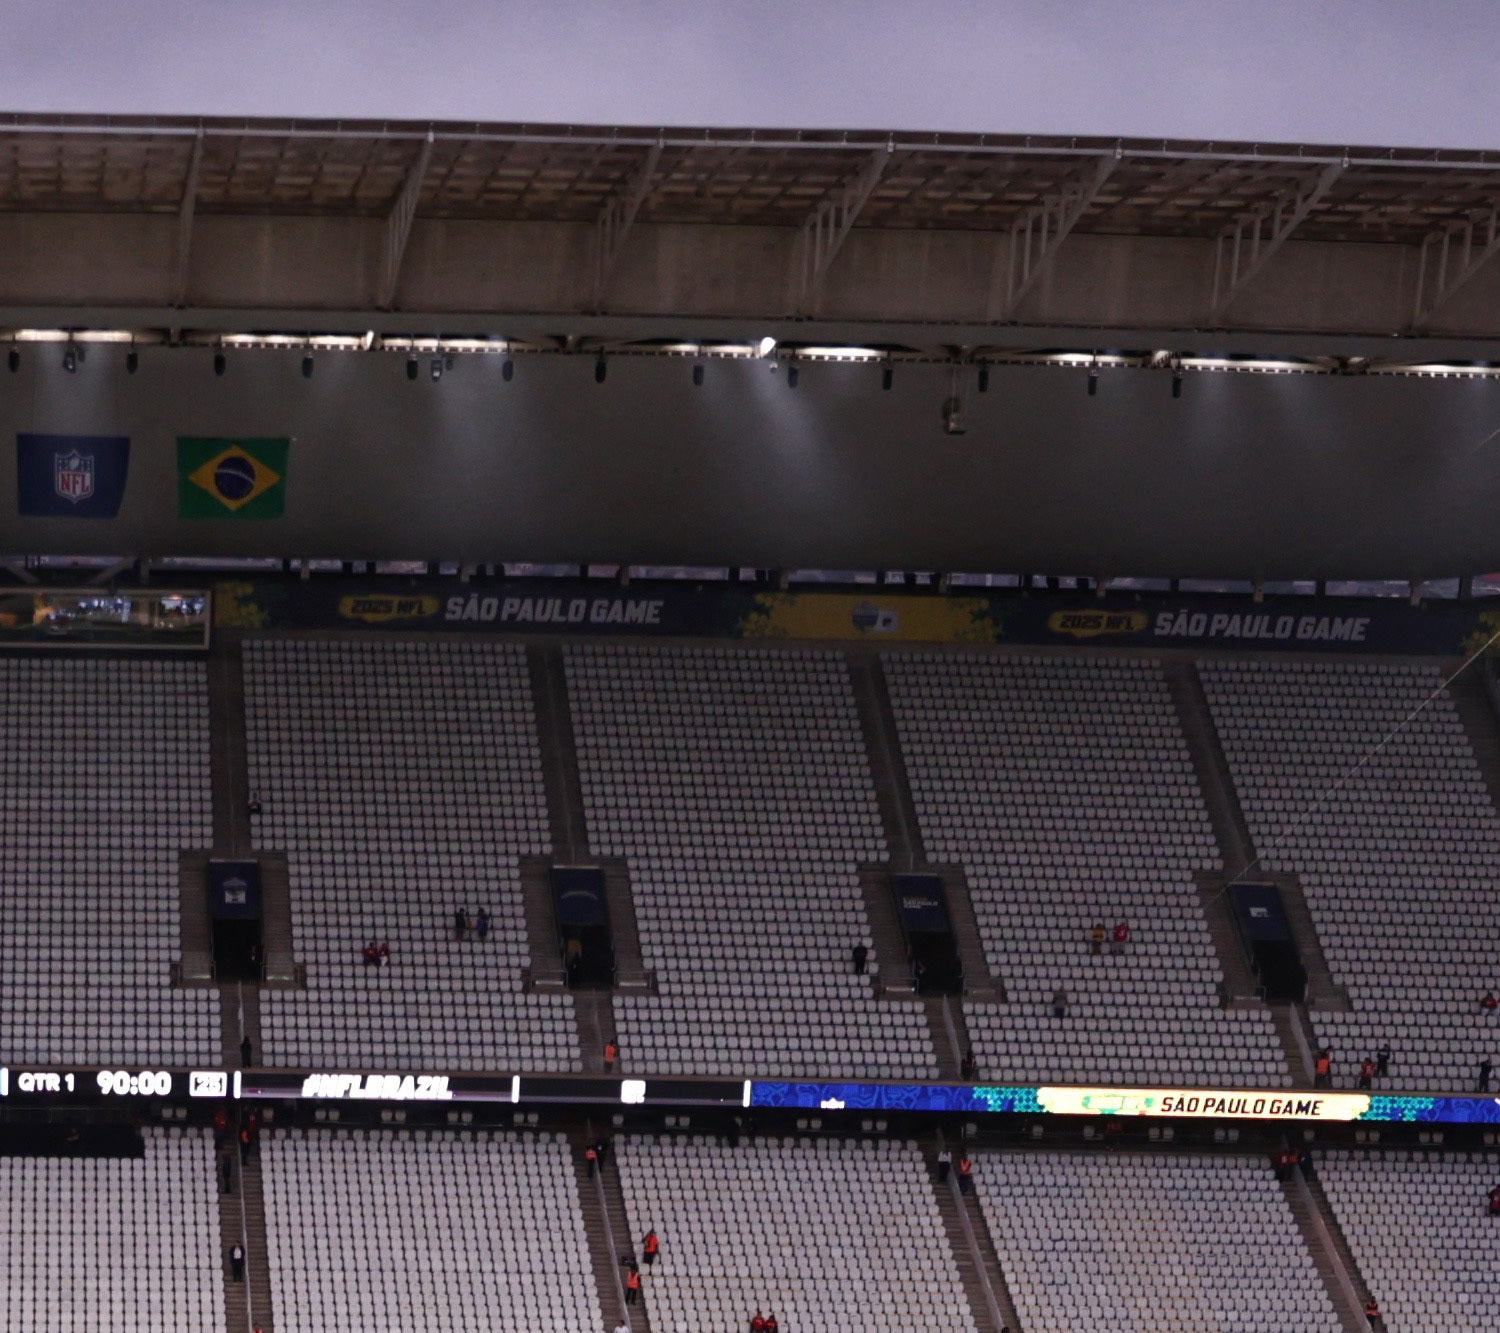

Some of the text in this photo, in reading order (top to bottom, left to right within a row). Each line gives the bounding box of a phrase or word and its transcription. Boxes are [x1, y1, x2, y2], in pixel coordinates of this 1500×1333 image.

[59, 474, 92, 496] NFL
[351, 600, 425, 615] 2025 NFL
[446, 594, 665, 624] SÃO PAULO GAME
[1060, 615, 1135, 631] 2025 NFL
[1154, 609, 1371, 641] SÃO PAULO GAME
[18, 1073, 60, 1093] QTR
[65, 1073, 75, 1092] 1
[96, 1071, 172, 1095] 90:00
[1203, 1098, 1265, 1114] PAULO
[1270, 1099, 1324, 1116] GAME
